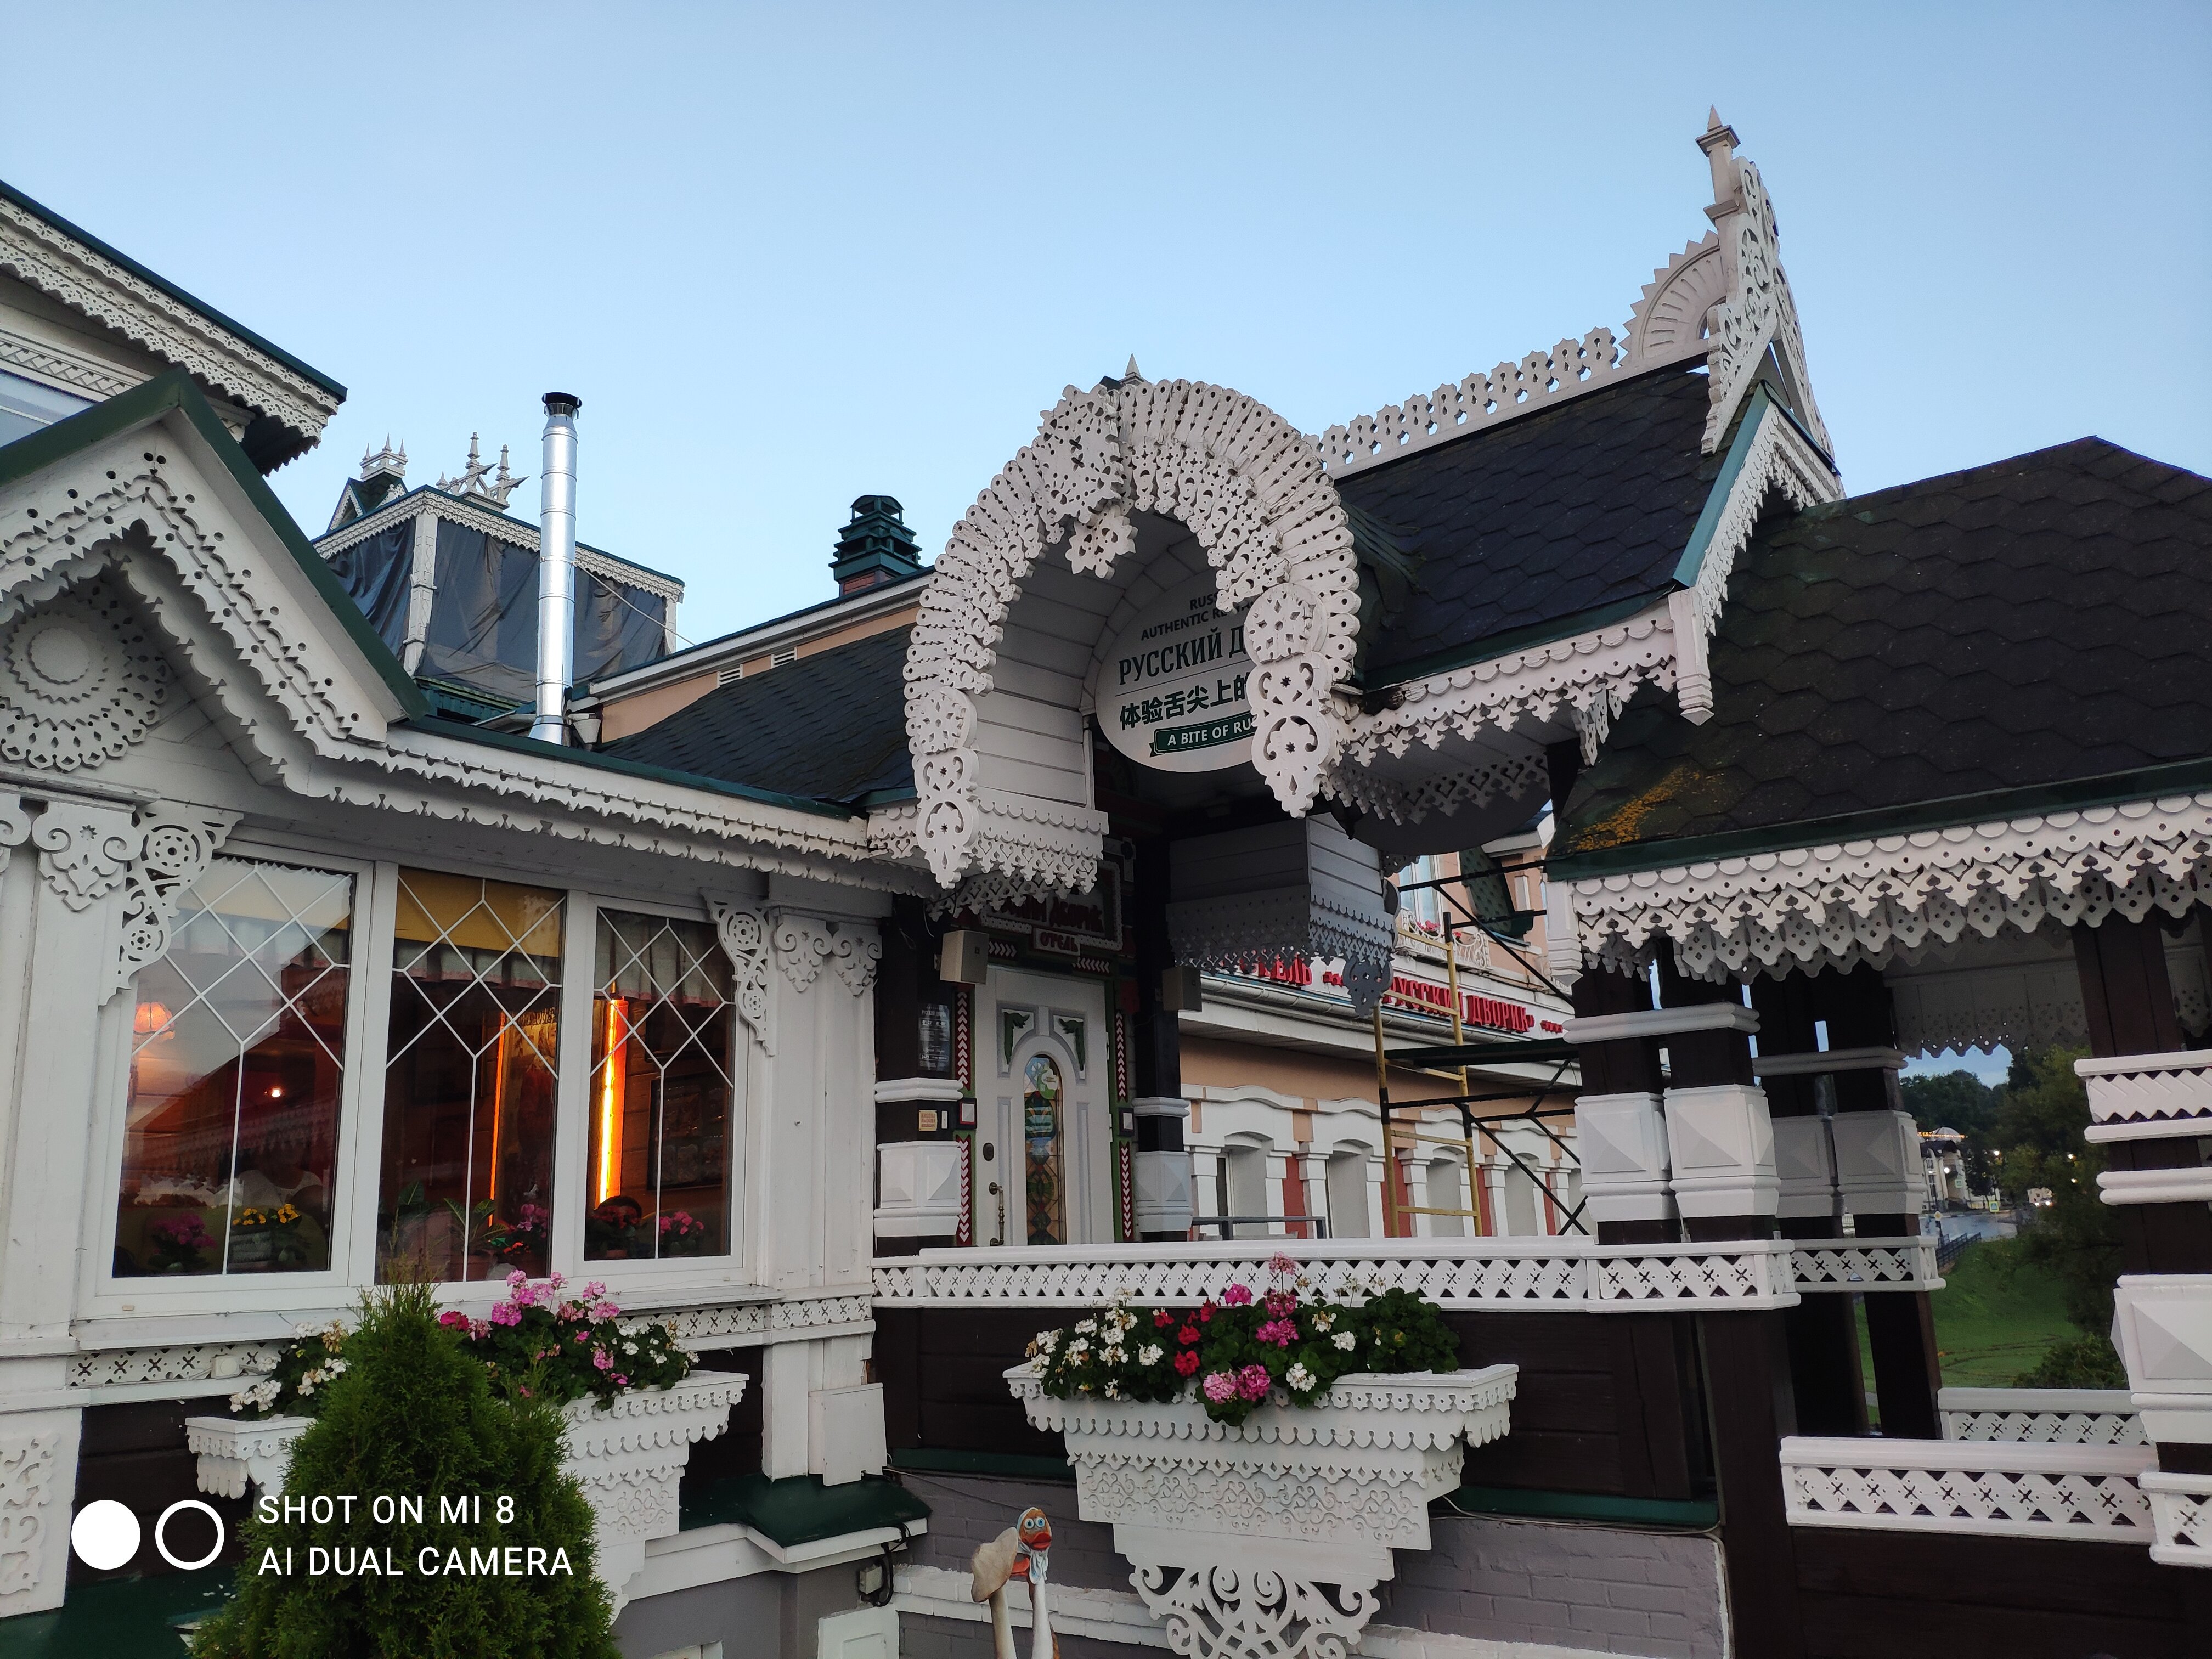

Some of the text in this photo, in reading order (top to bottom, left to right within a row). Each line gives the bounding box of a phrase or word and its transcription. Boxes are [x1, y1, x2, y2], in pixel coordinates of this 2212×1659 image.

[1141, 611, 1209, 641] AUTHENTIC
[1119, 627, 1223, 686] РУССКИЙ
[1167, 733, 1177, 746] A
[1181, 729, 1208, 745] BITE
[1212, 724, 1229, 740] OF
